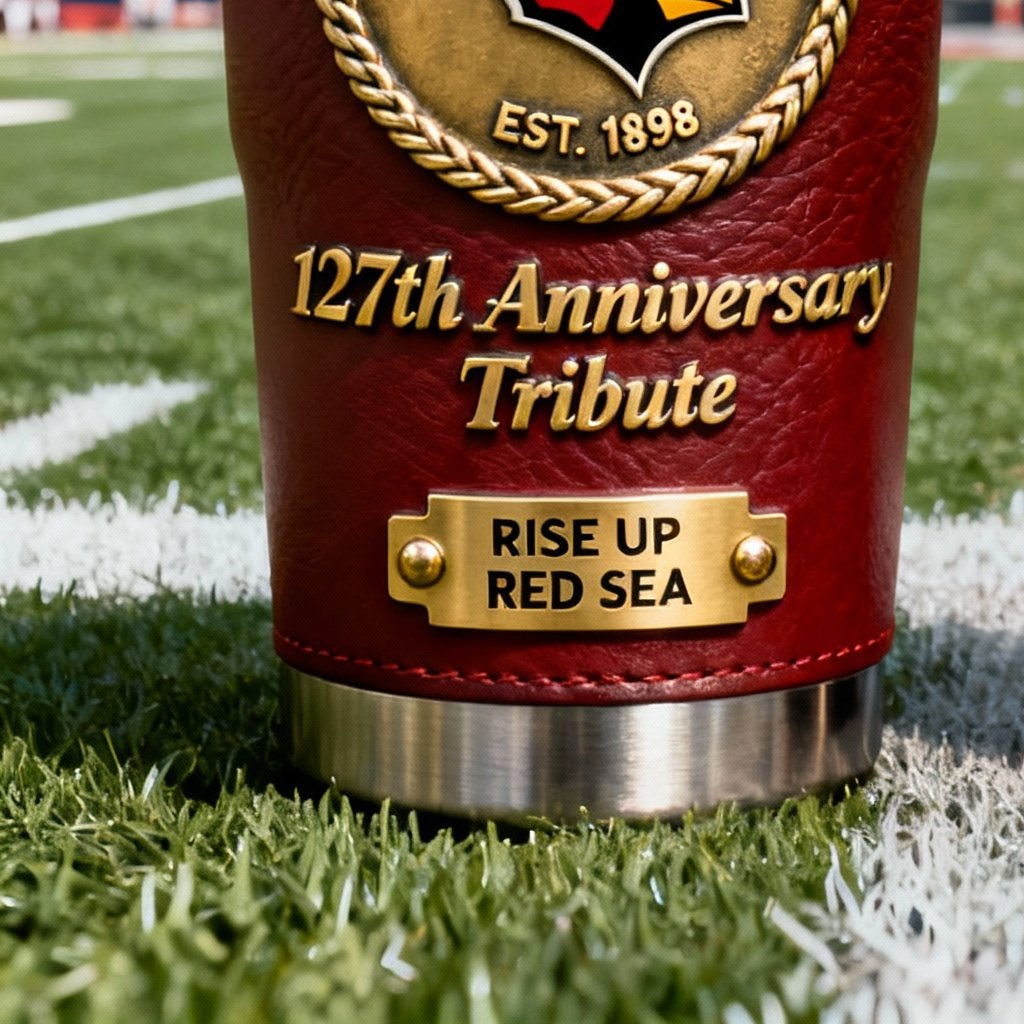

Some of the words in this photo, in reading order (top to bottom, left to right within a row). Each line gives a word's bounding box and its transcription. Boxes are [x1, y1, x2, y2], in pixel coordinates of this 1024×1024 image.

[492, 100, 587, 157] EST.
[601, 98, 701, 156] 1898
[291, 244, 464, 330] 127th
[472, 260, 894, 335] Anniversary
[460, 352, 738, 432] Tribute
[492, 517, 599, 557] RISE
[616, 516, 681, 556] UP
[487, 570, 584, 611] RED
[599, 567, 693, 610] SEA
